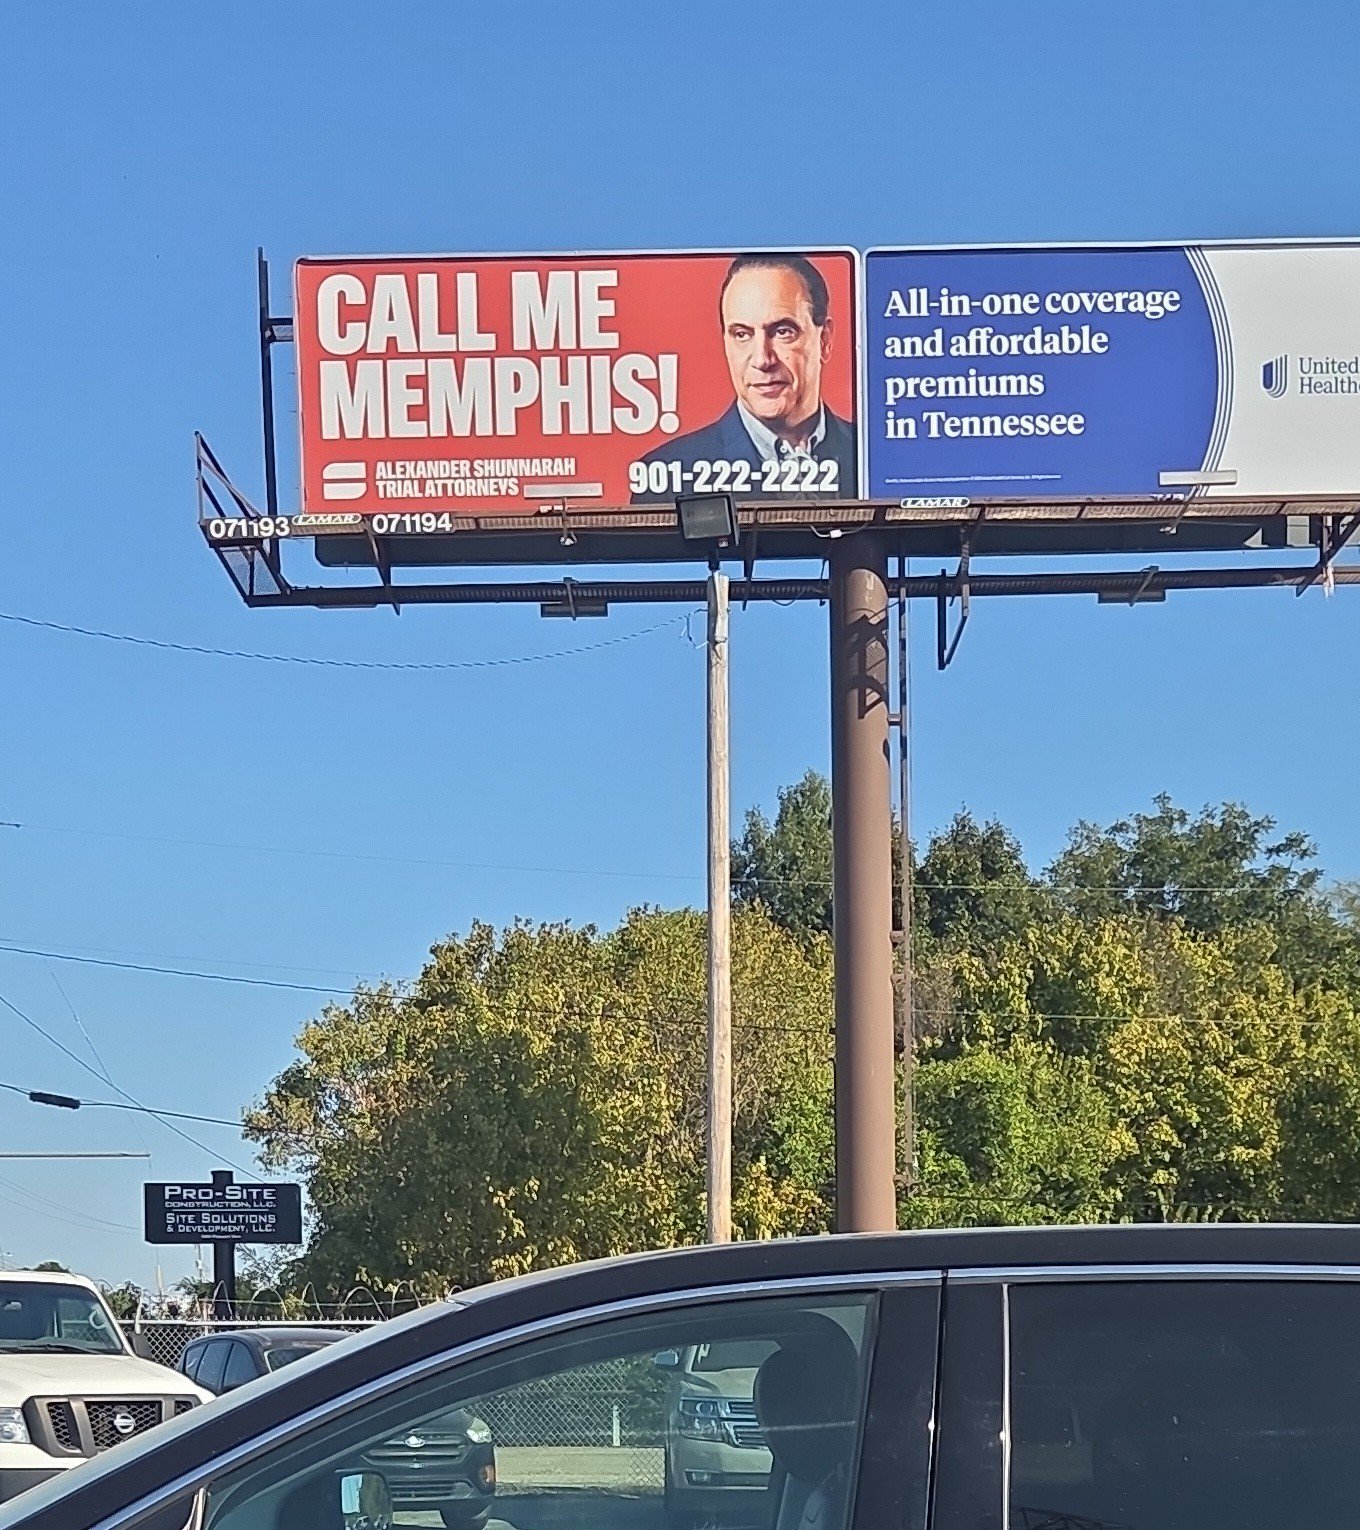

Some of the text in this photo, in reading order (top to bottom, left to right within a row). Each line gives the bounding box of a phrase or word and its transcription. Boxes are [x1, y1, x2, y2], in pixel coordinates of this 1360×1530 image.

[317, 269, 620, 355] CALL ME
[884, 288, 1181, 319] All-in-one coverage
[884, 326, 1109, 358] and affordable
[1299, 356, 1359, 374] United
[320, 354, 681, 439] MEMPHIS!
[885, 369, 1045, 405] premiums
[885, 410, 1085, 440] in Tennessee
[375, 457, 576, 480] ALEXANDER SHUNNARAH
[628, 460, 840, 494] 901-222-2222
[375, 477, 520, 498] TRIAL ATTORNEYS
[906, 498, 964, 507] LAMAR
[209, 518, 290, 539] 071193
[296, 514, 356, 525] LAMAR
[372, 513, 453, 533] 071194
[166, 1225, 174, 1233] &
[252, 1224, 276, 1233] LLC.
